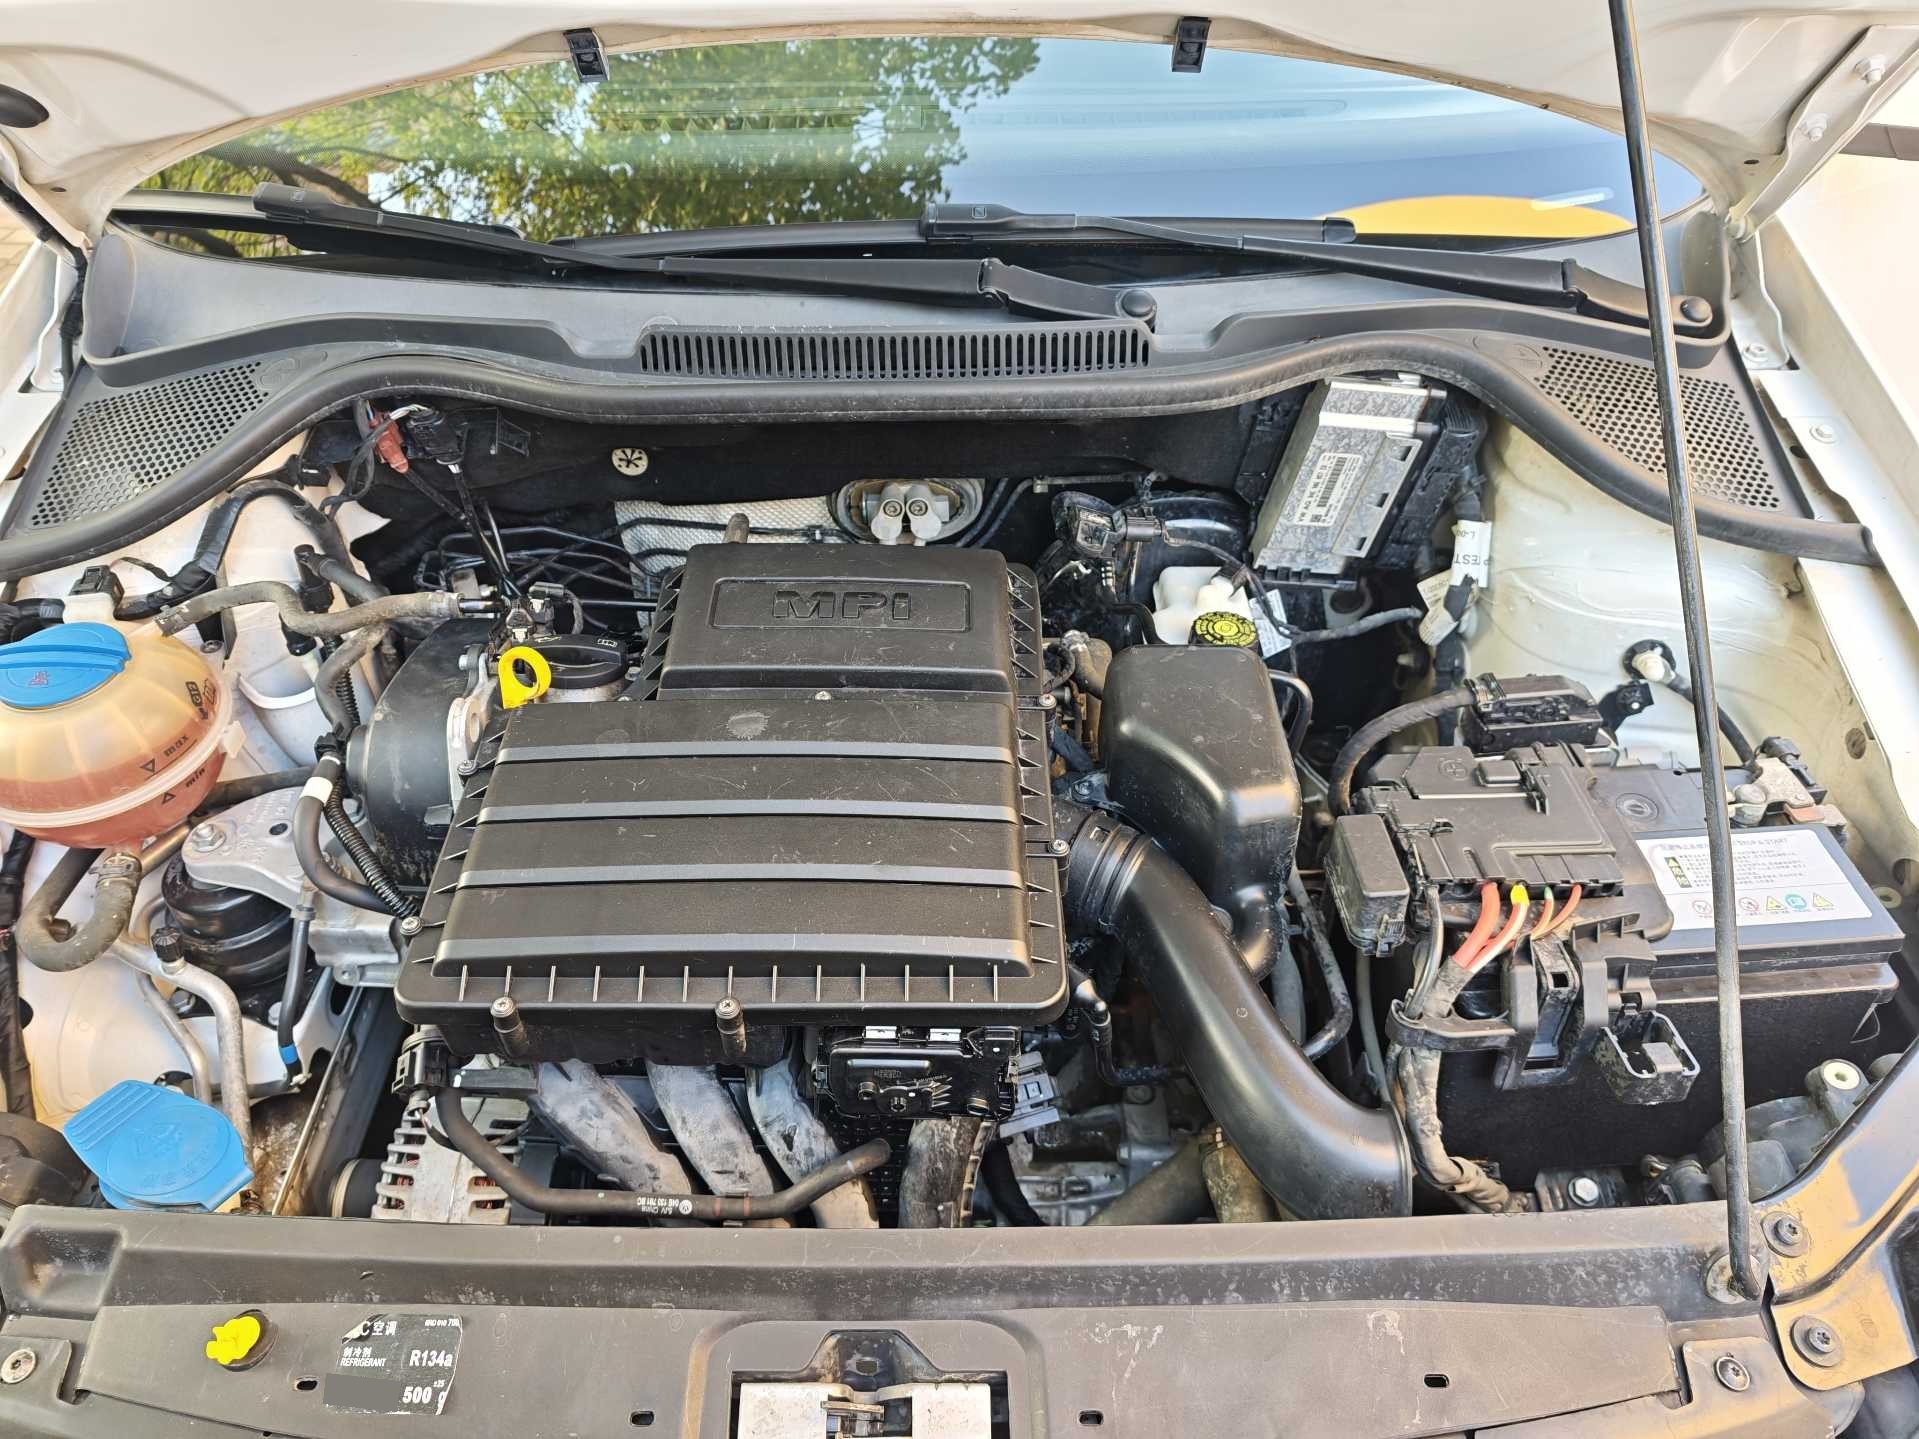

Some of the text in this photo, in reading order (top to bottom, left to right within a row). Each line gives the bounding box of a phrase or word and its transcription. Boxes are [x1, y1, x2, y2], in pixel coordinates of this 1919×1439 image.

[772, 590, 912, 621] MPI
[163, 734, 189, 757] max
[185, 767, 205, 788] min
[372, 1320, 397, 1336] 空调
[342, 1346, 372, 1359] 制冷剂
[409, 1350, 453, 1367] R134a
[340, 1358, 387, 1368] REFRIGERANT
[402, 1386, 432, 1404] 500
